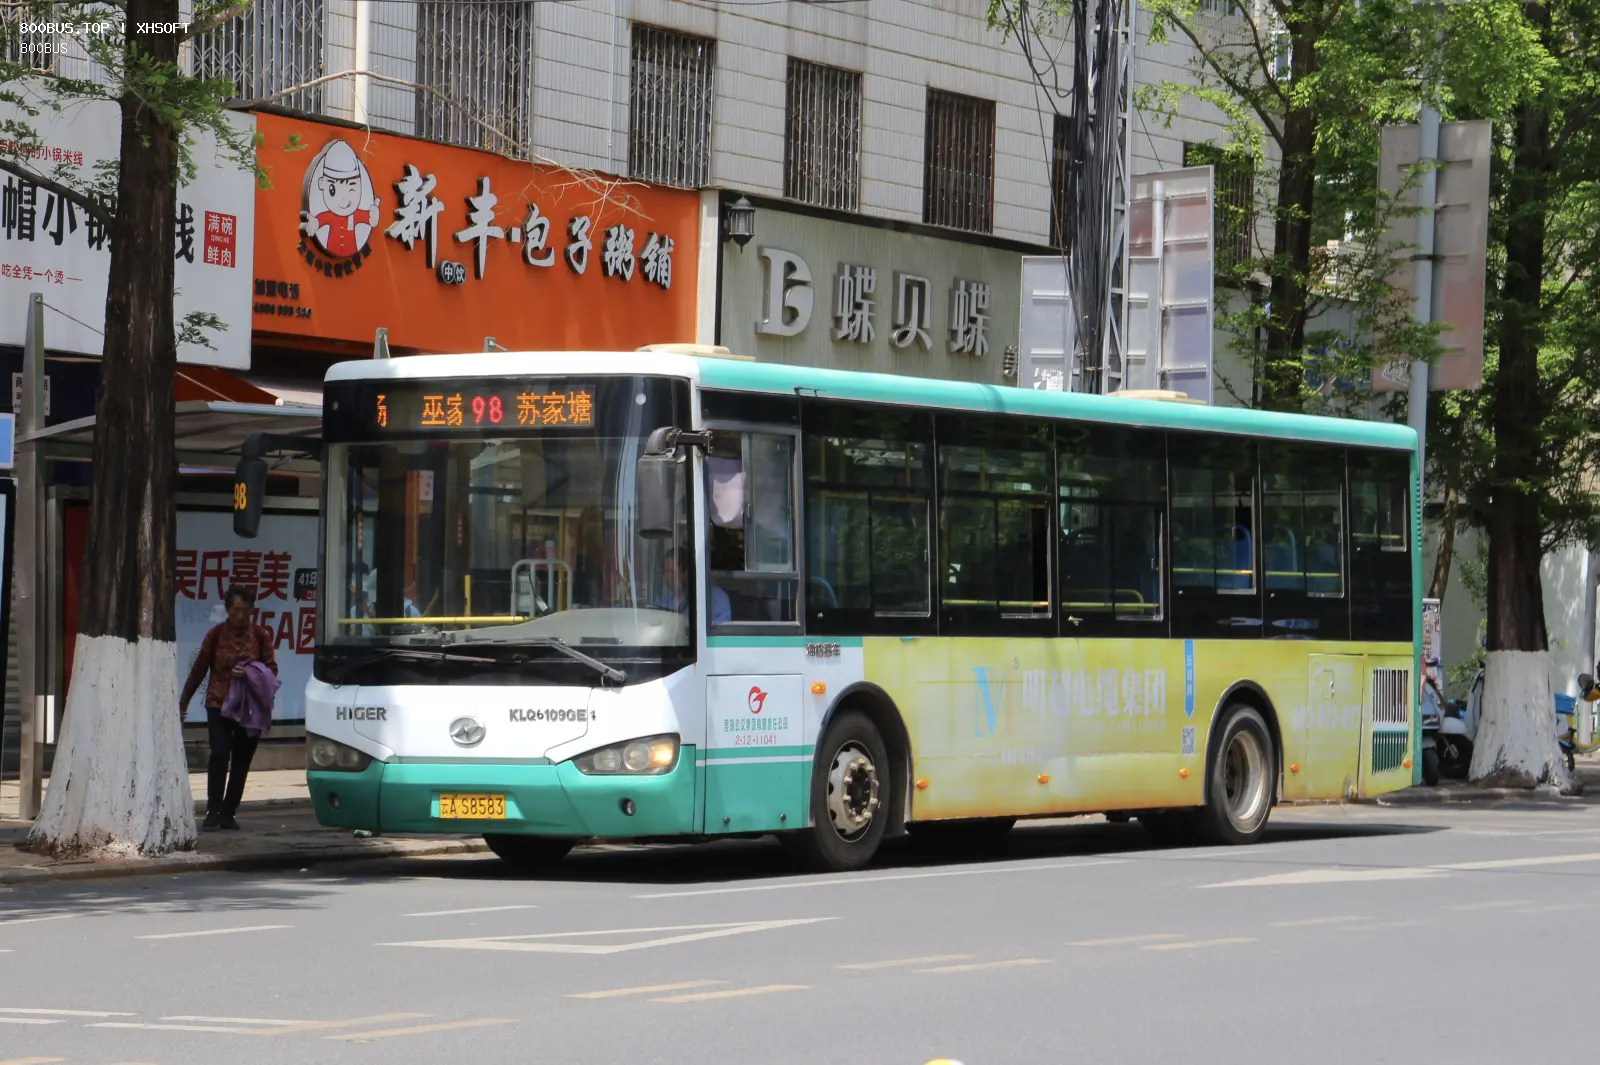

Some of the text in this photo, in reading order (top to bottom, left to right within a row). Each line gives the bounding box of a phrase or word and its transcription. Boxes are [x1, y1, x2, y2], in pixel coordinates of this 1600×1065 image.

[208, 214, 233, 235] 满碗
[207, 246, 232, 267] 鲜肉
[831, 262, 992, 357] 蝶贝蝶
[471, 396, 504, 424] 98
[516, 391, 593, 425] 苏家塘
[234, 482, 247, 510] 98
[335, 705, 388, 721] HIGER
